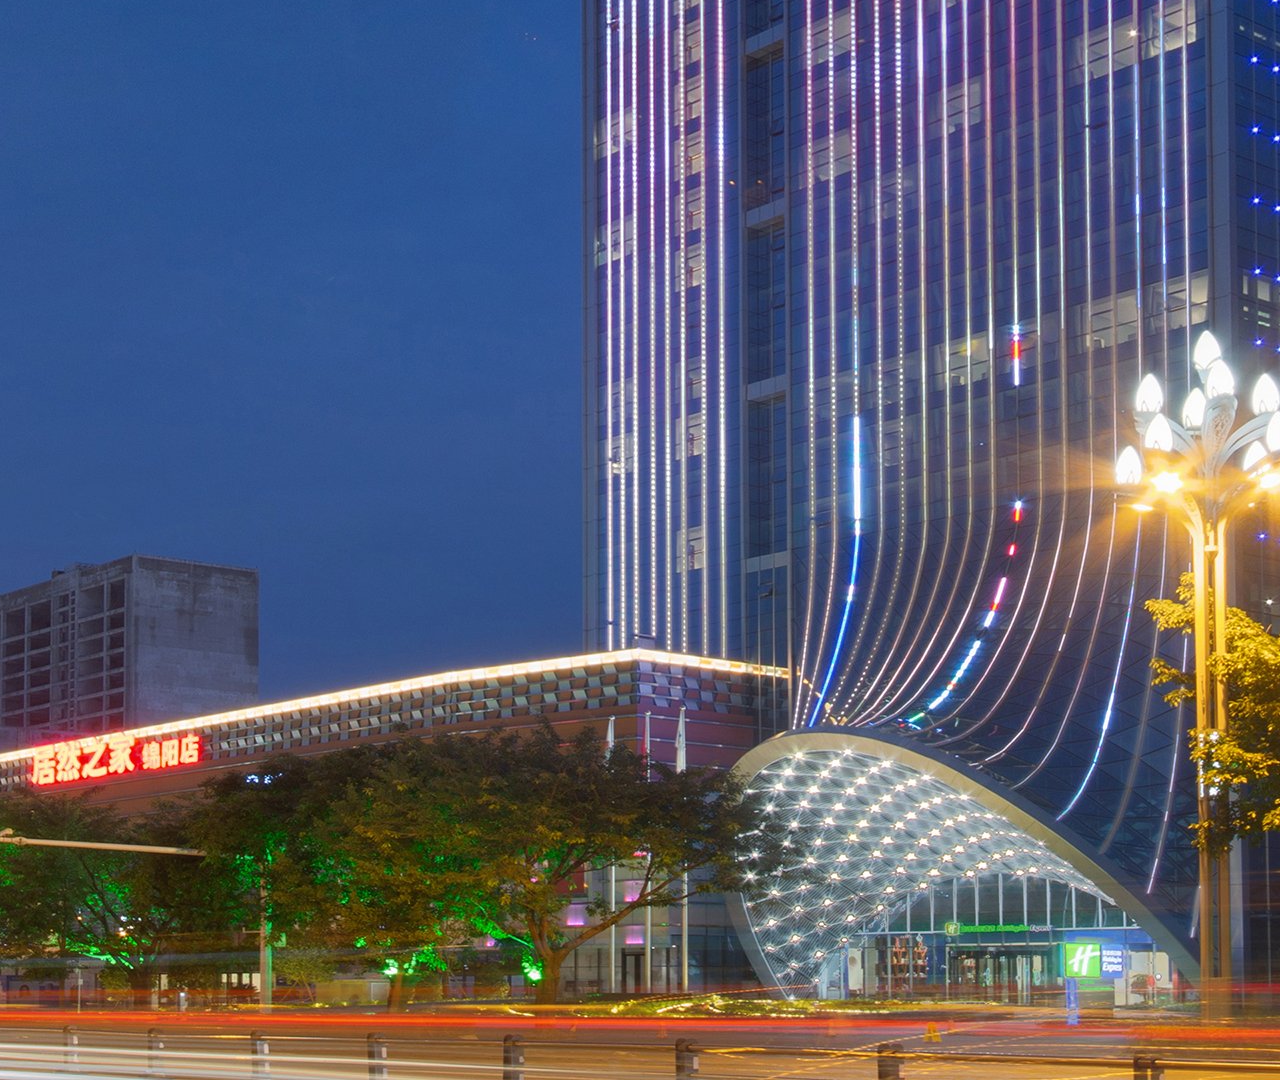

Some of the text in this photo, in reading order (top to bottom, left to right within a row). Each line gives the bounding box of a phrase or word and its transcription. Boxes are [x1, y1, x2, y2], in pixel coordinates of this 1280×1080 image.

[32, 733, 200, 785] 居然之家 绵阳店
